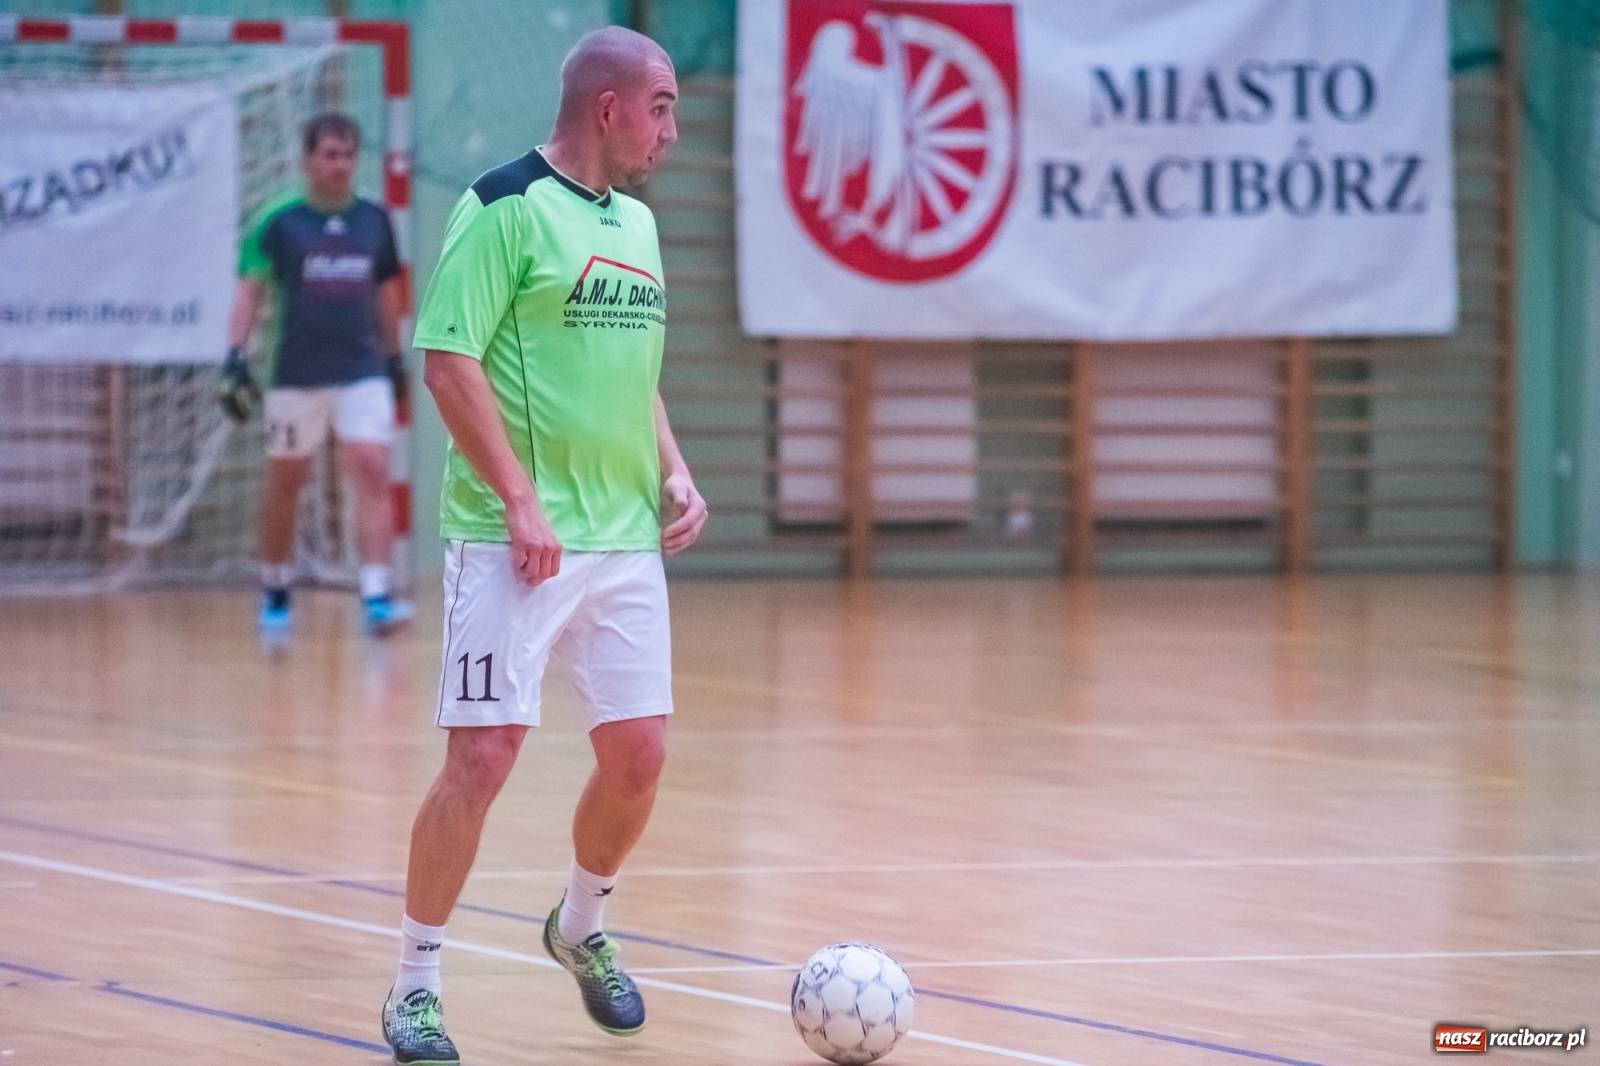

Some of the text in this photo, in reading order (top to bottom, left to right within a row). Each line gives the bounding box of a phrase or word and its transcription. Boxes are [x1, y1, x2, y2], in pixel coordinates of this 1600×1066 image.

[1088, 59, 1376, 124] MIASTO
[1038, 137, 1428, 219] RACIBÓRZ
[600, 217, 621, 227] JAKO
[565, 278, 622, 305] A.M.J.
[563, 321, 648, 330] SYRYNIA
[564, 310, 599, 318] USŁUGI
[456, 651, 500, 701] 11
